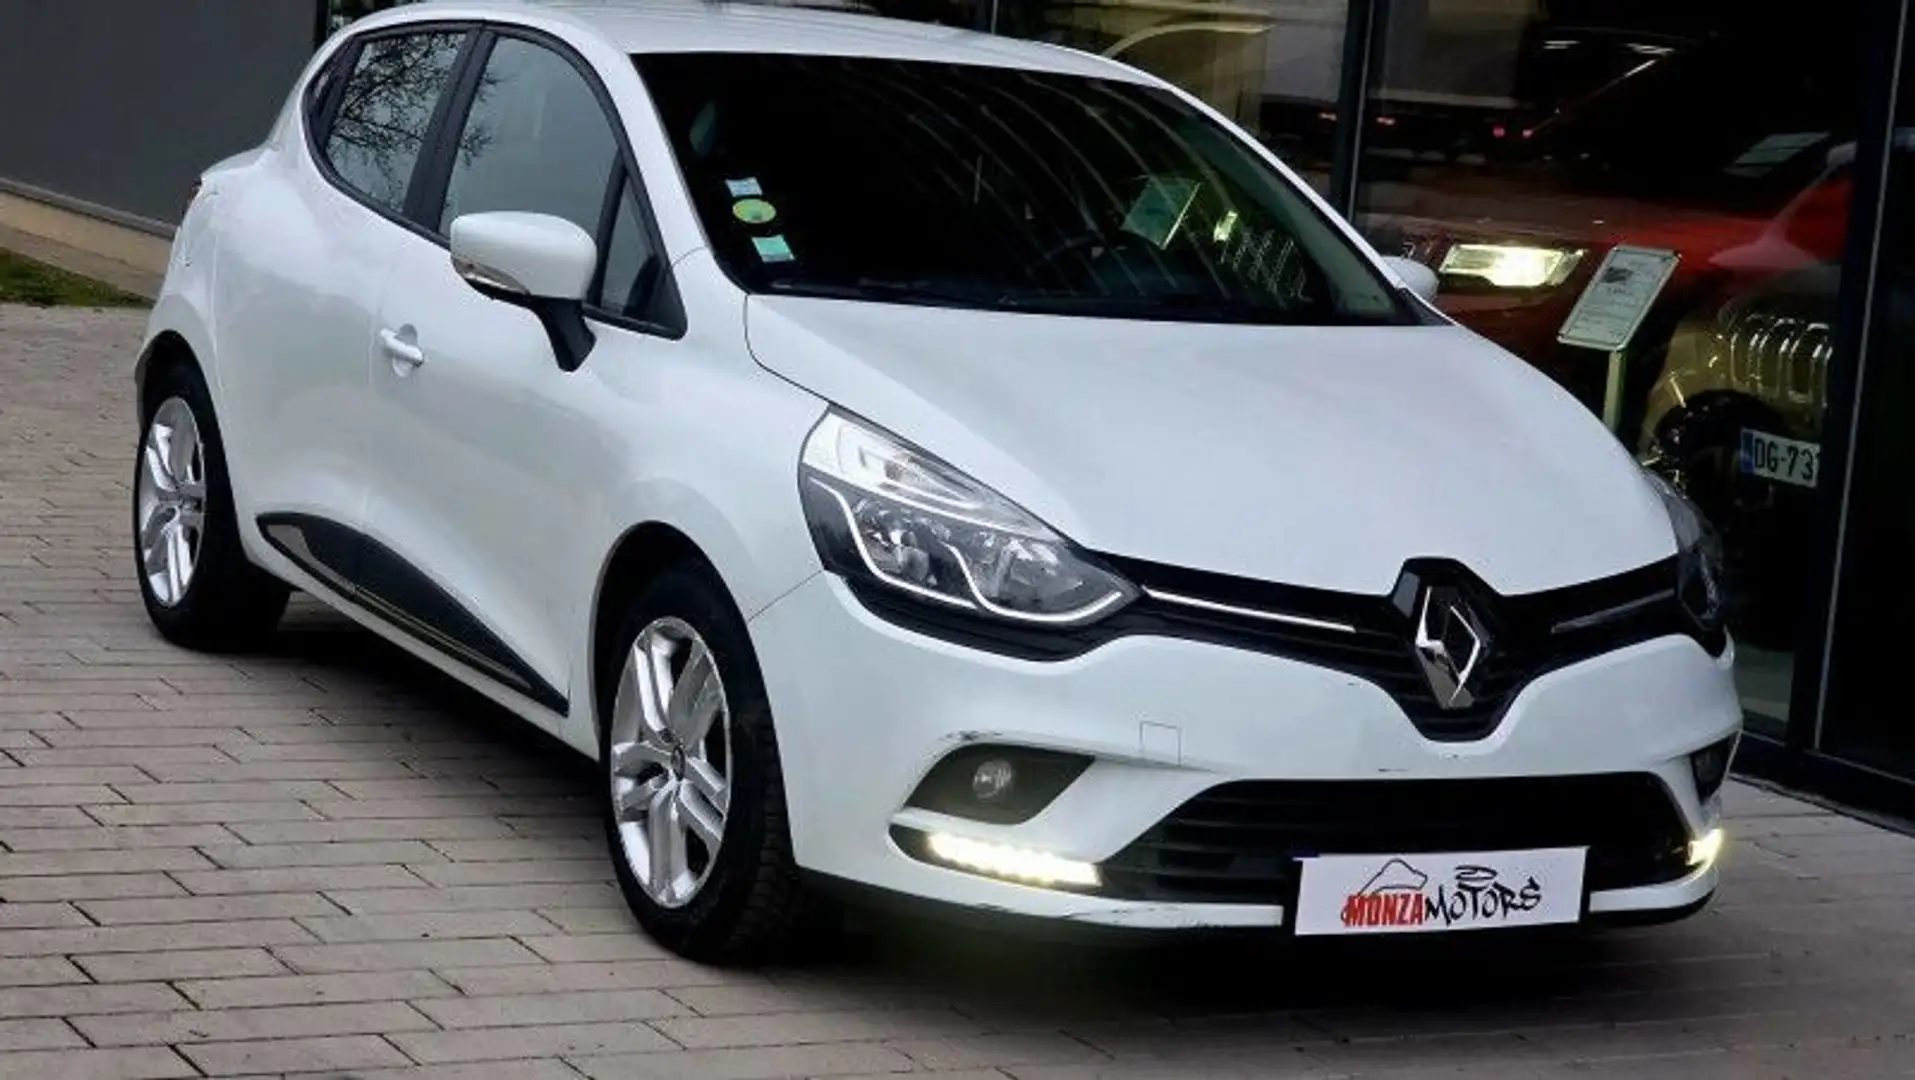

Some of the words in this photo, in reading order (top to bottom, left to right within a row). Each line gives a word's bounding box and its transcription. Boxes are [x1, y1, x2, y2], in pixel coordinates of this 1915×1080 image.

[1755, 438, 1820, 480] DG-73
[1341, 893, 1424, 928] MONZA
[1424, 877, 1542, 926] MOTORS
